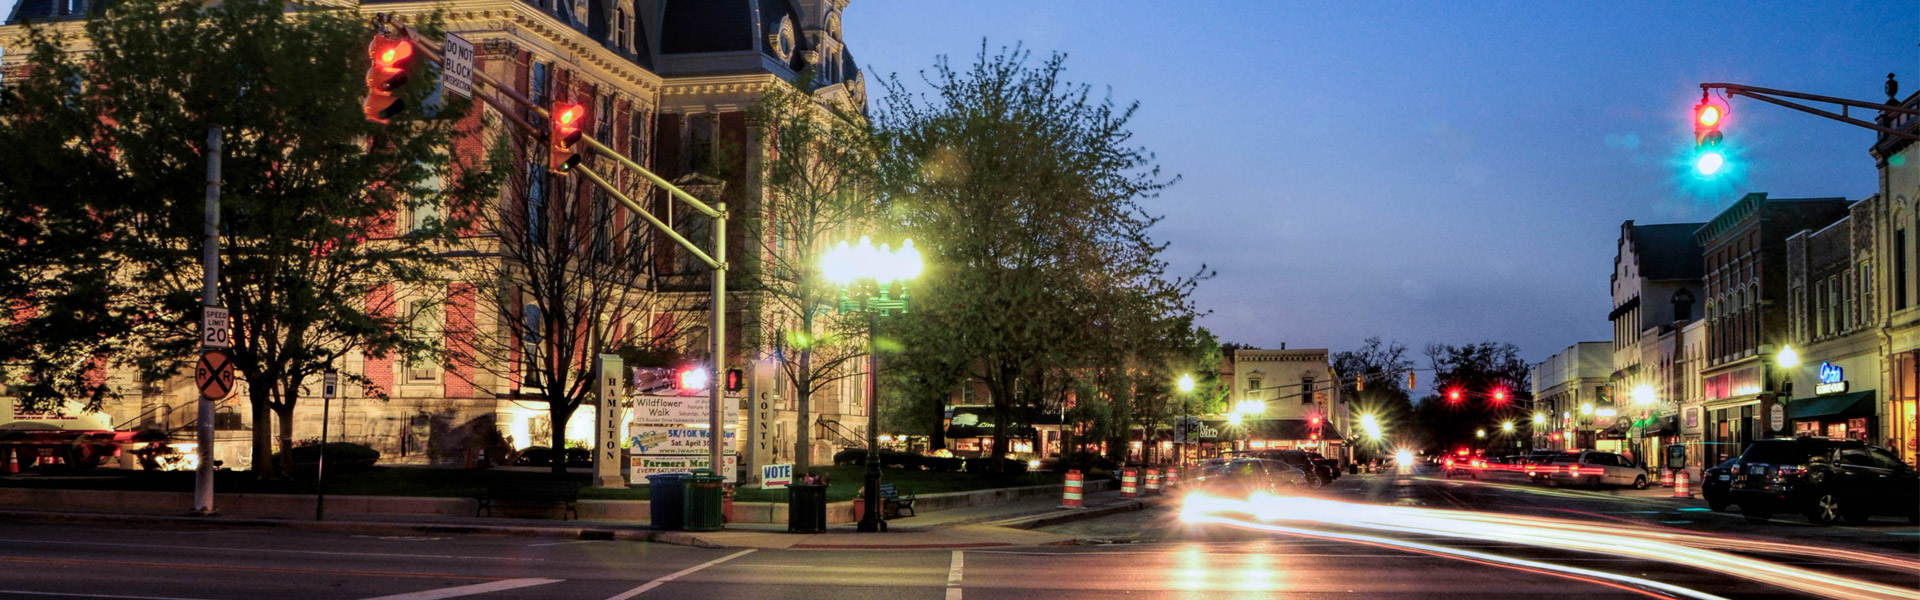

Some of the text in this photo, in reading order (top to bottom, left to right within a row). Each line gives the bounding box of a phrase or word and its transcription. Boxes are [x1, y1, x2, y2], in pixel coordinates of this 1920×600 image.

[447, 39, 473, 63] DO NOT
[446, 57, 472, 79] BLOCK
[445, 74, 471, 91] INTERSECTION
[206, 311, 227, 319] SPEED
[206, 327, 226, 342] 20
[199, 368, 231, 382] R R
[636, 398, 683, 408] Wildflower
[607, 378, 616, 460] HAMILTON
[649, 408, 670, 417] Walk
[668, 429, 698, 438] 5K/10K
[685, 440, 701, 448] April
[643, 459, 686, 467] Farmers
[764, 465, 790, 479] VOTE
